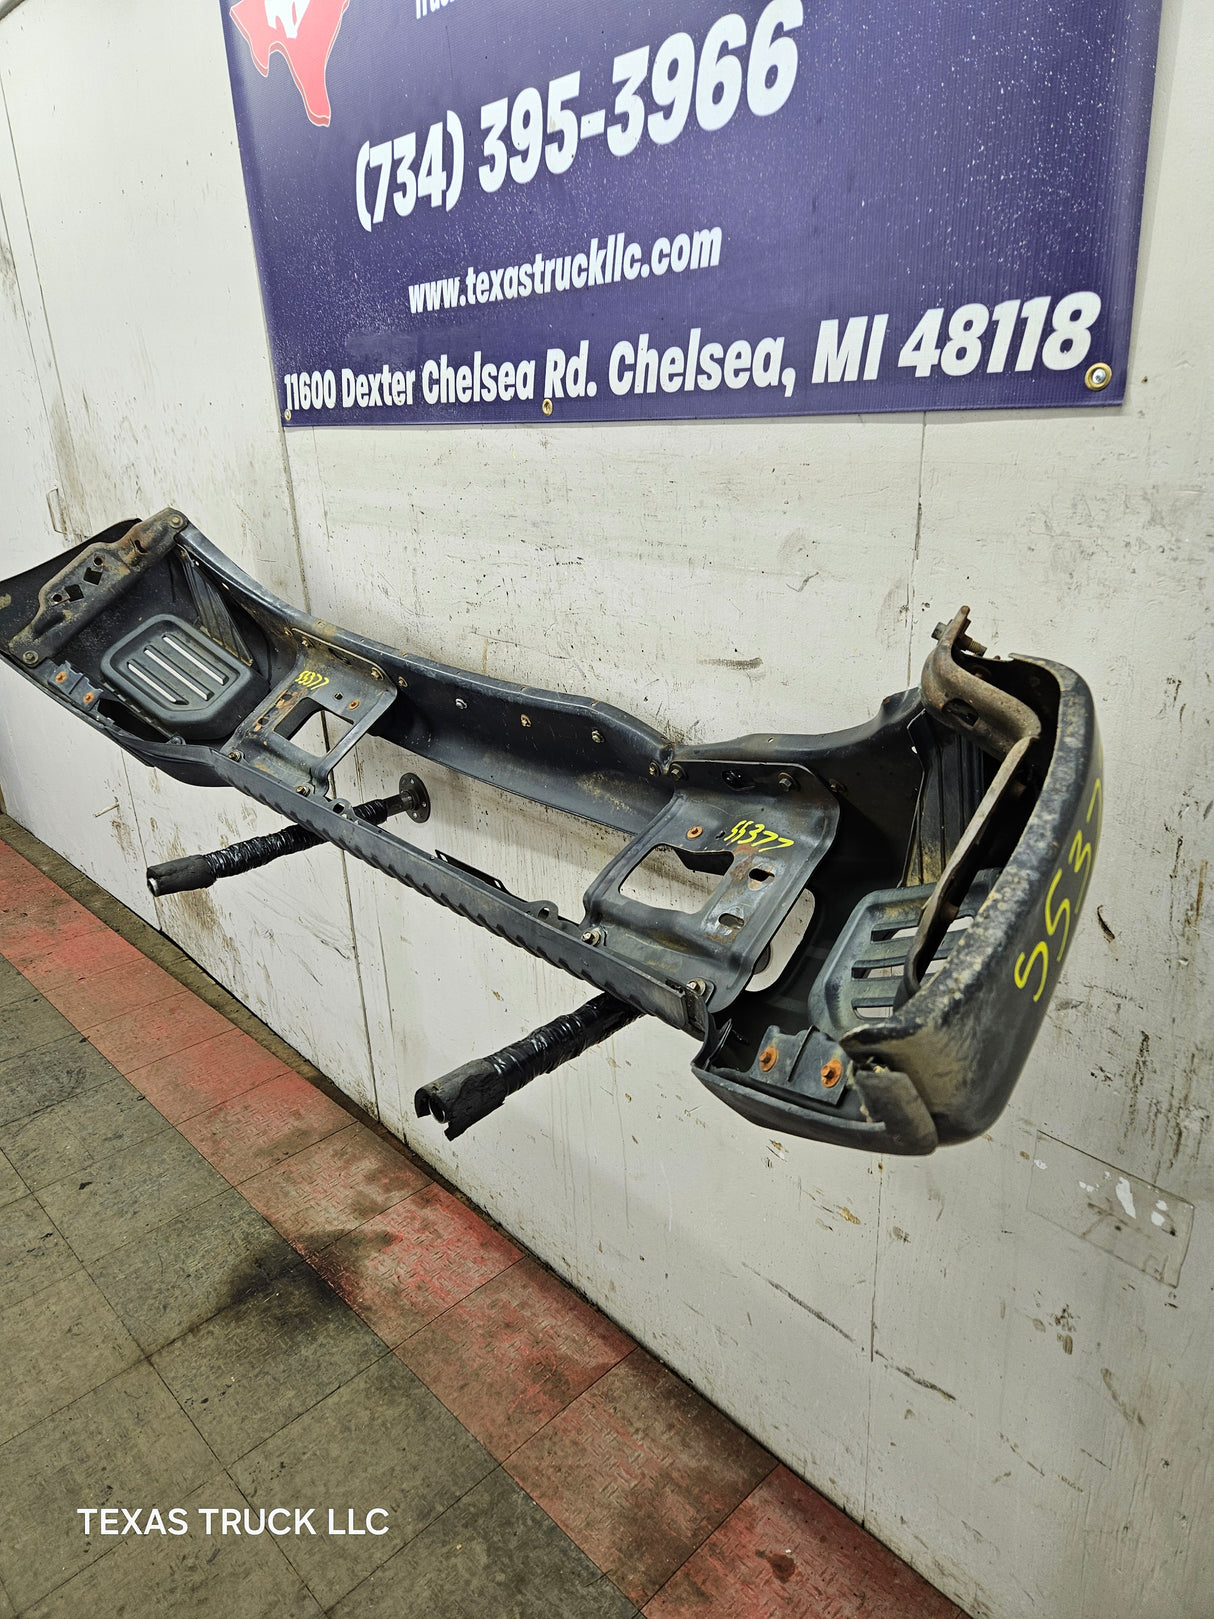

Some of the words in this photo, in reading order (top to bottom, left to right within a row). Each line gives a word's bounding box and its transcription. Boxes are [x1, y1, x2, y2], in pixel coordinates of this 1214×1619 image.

[355, 109, 465, 233] (734)
[478, 0, 804, 194] 395-3966
[408, 226, 723, 314] www.texastruckllc.com
[284, 369, 336, 411] 11600
[341, 364, 416, 408] Dexter
[422, 350, 536, 405] Chelsea
[544, 339, 598, 399] Rd.
[608, 327, 797, 398] Chelsea,
[811, 313, 890, 384] MI
[898, 291, 1103, 378] 48118
